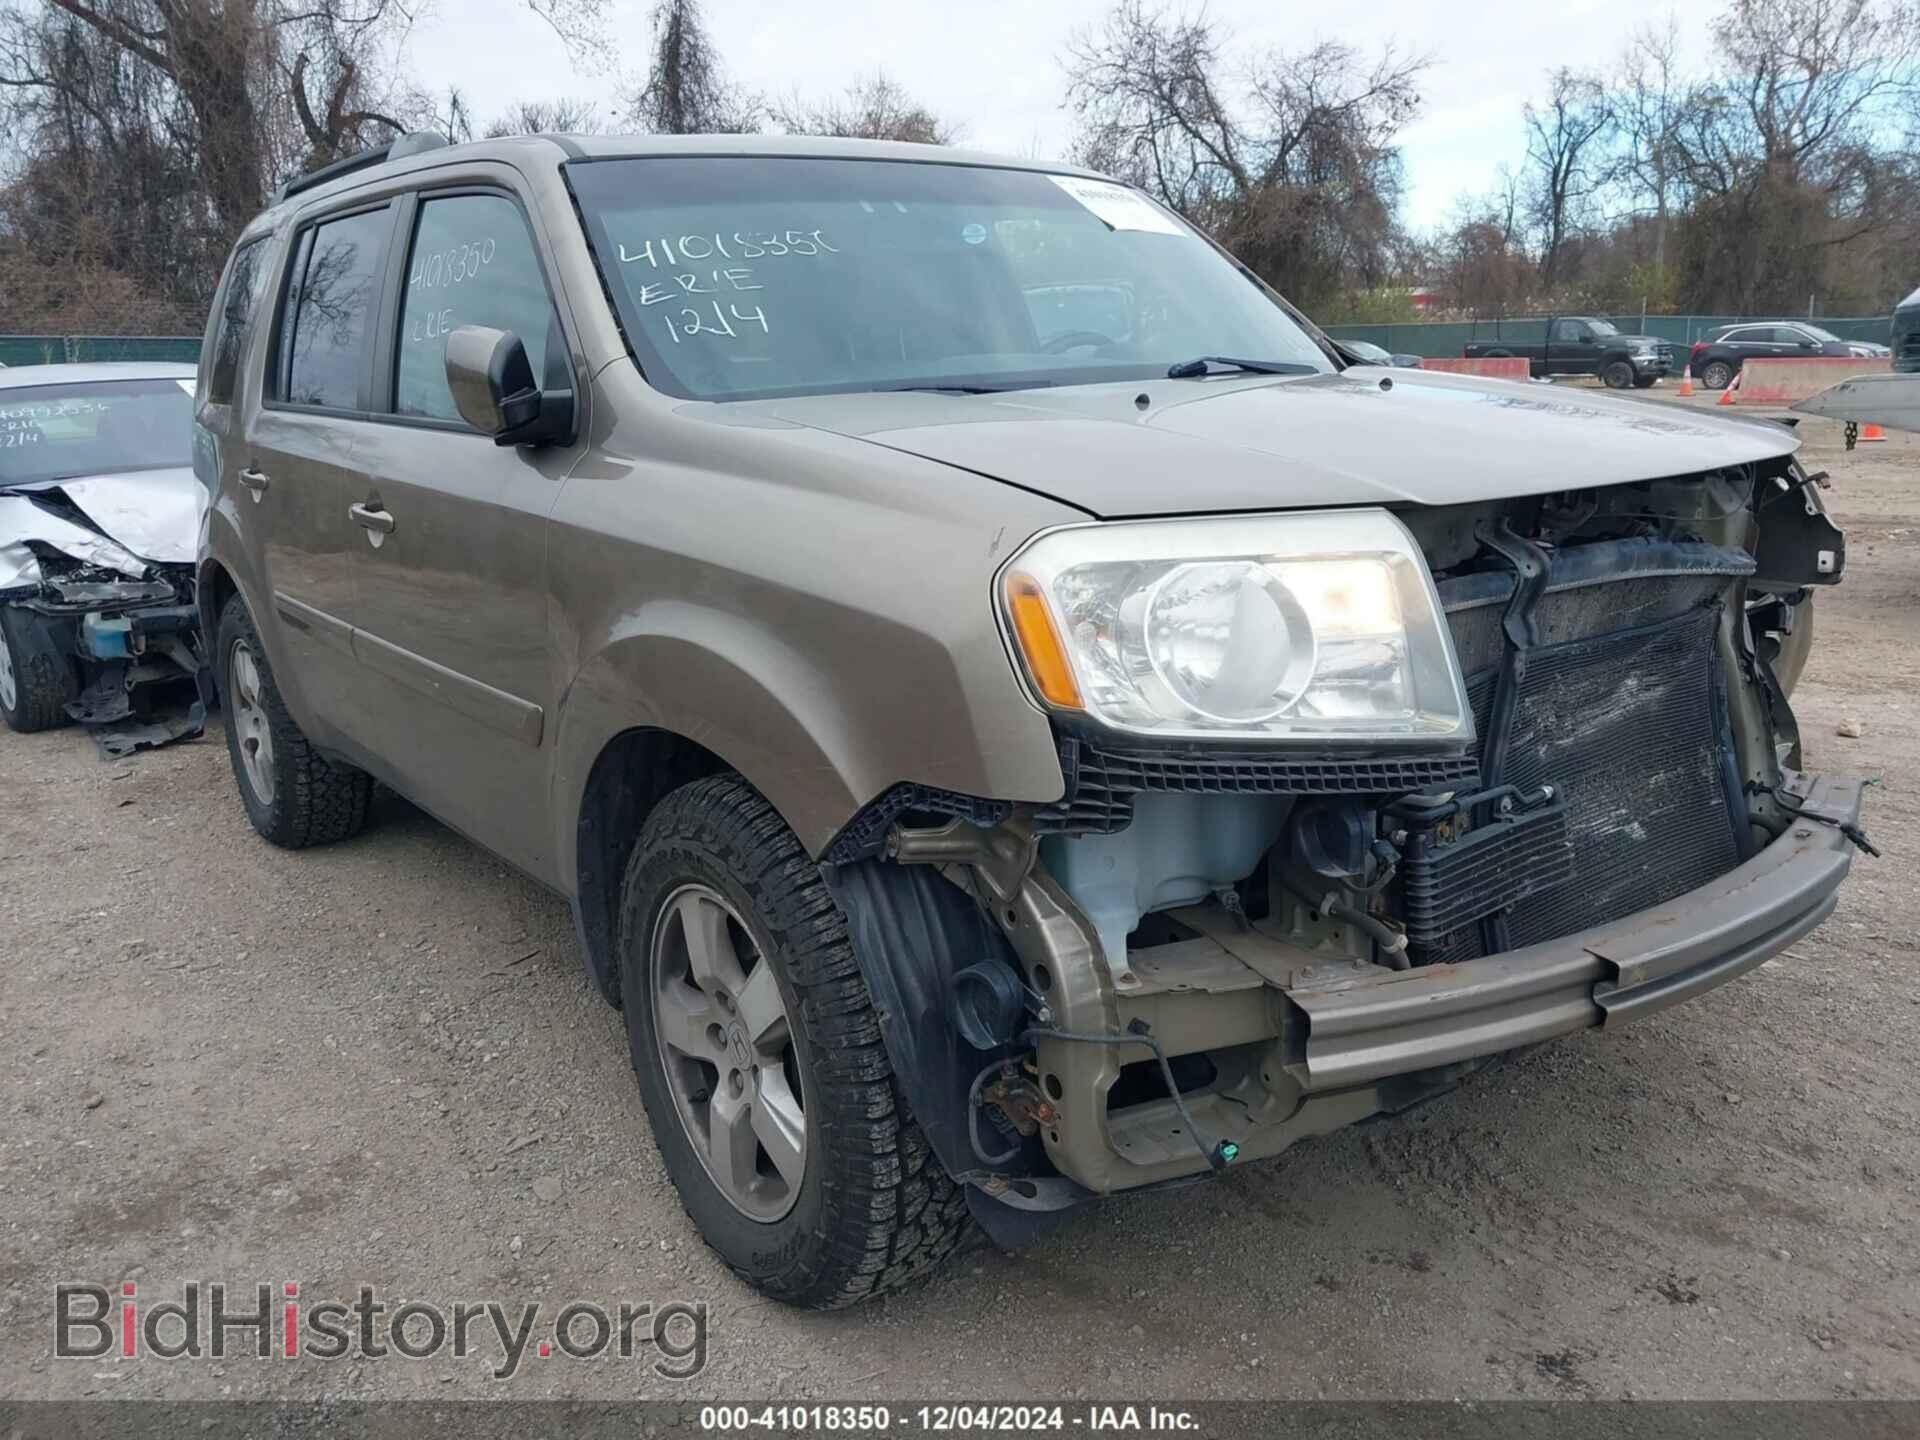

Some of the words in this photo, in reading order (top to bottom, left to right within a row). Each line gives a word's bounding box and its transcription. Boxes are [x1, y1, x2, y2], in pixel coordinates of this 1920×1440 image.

[640, 268, 765, 305] ERIE
[664, 300, 769, 343] 12/4
[0, 431, 39, 448] 2/4
